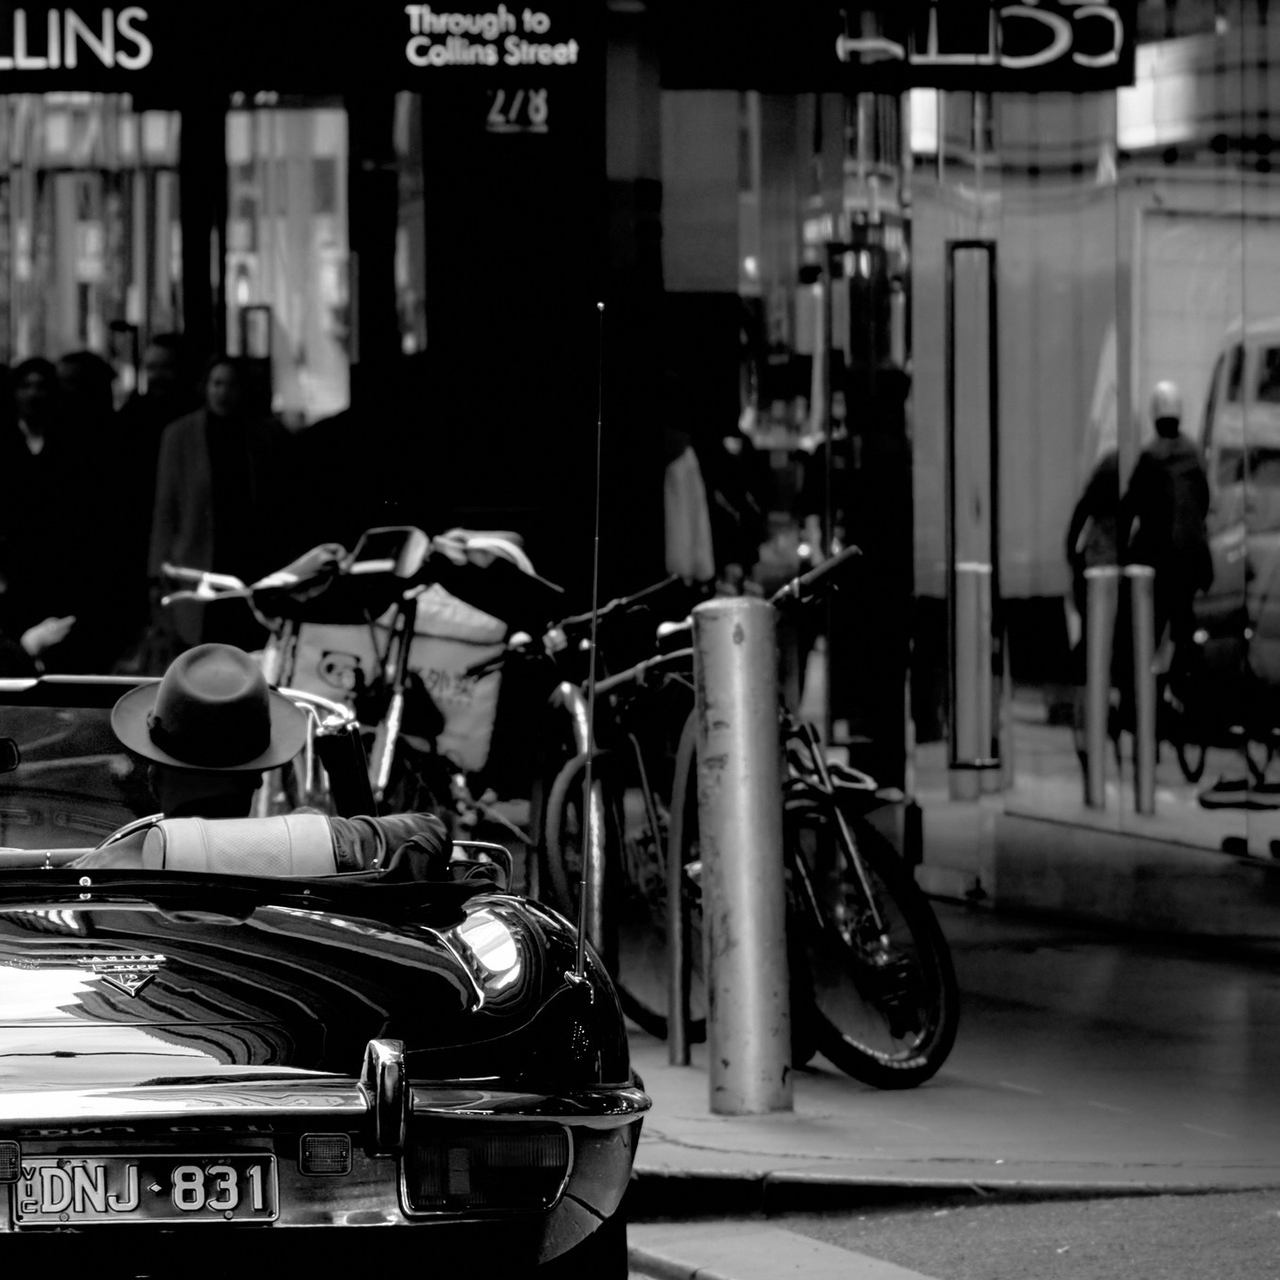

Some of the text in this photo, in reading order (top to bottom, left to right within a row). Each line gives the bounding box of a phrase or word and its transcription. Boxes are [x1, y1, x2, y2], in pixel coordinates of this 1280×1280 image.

[403, 2, 552, 42] Through to
[404, 33, 580, 68] Collins Street
[21, 1166, 38, 1214] VIC
